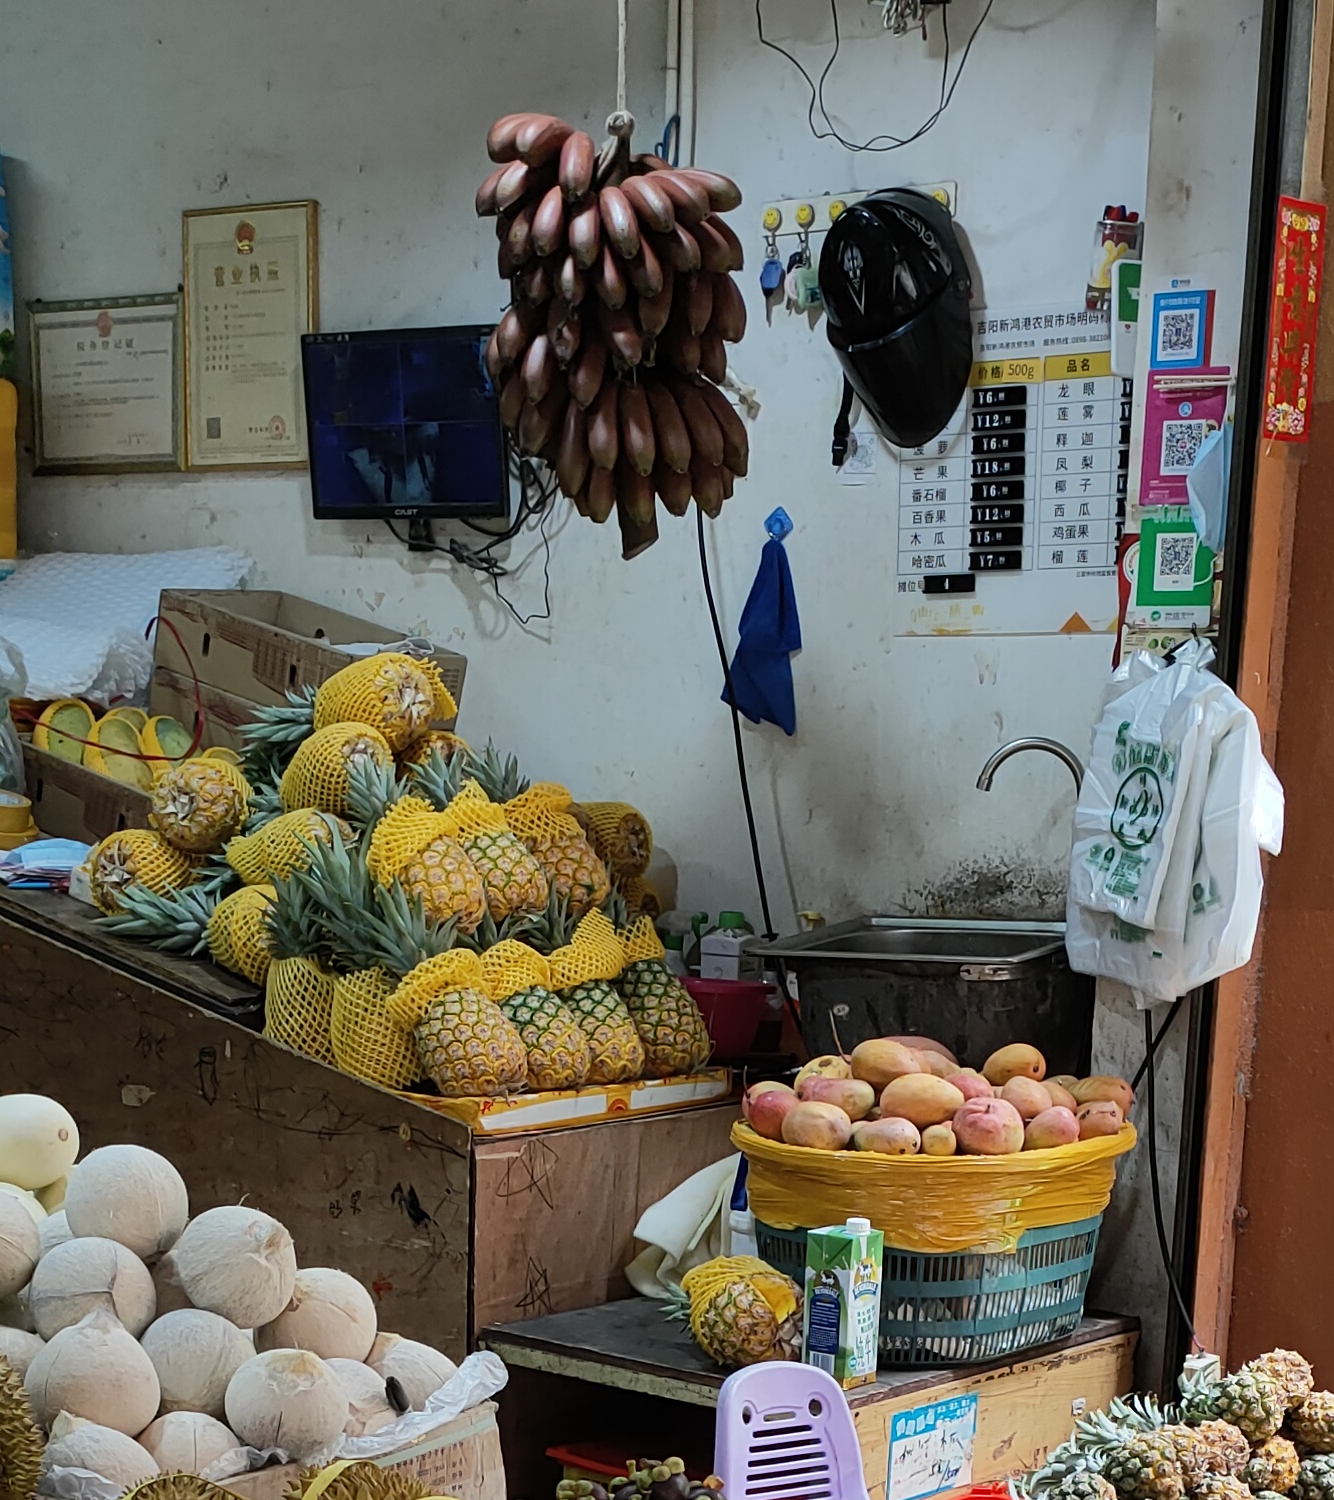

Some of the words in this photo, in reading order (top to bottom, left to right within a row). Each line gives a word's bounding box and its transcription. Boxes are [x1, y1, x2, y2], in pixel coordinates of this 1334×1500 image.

[214, 262, 279, 287] 营业执照
[1008, 364, 1034, 379] 500g
[1067, 358, 1090, 373] 品名
[1058, 382, 1095, 398] 龙眼
[1057, 405, 1094, 421] 莲雾
[1056, 432, 1094, 447] 释迦
[1056, 455, 1093, 471] 凤梨
[914, 466, 948, 480] 芒果
[1055, 478, 1092, 494] 椰子
[912, 489, 947, 502] 番石榴
[912, 510, 946, 524] 百香果
[1055, 502, 1090, 517] 西瓜
[910, 532, 945, 545] 木瓜
[1052, 525, 1089, 539] 鸡蛋果
[911, 555, 946, 569] 哈密瓜
[1052, 550, 1088, 564] 榴莲
